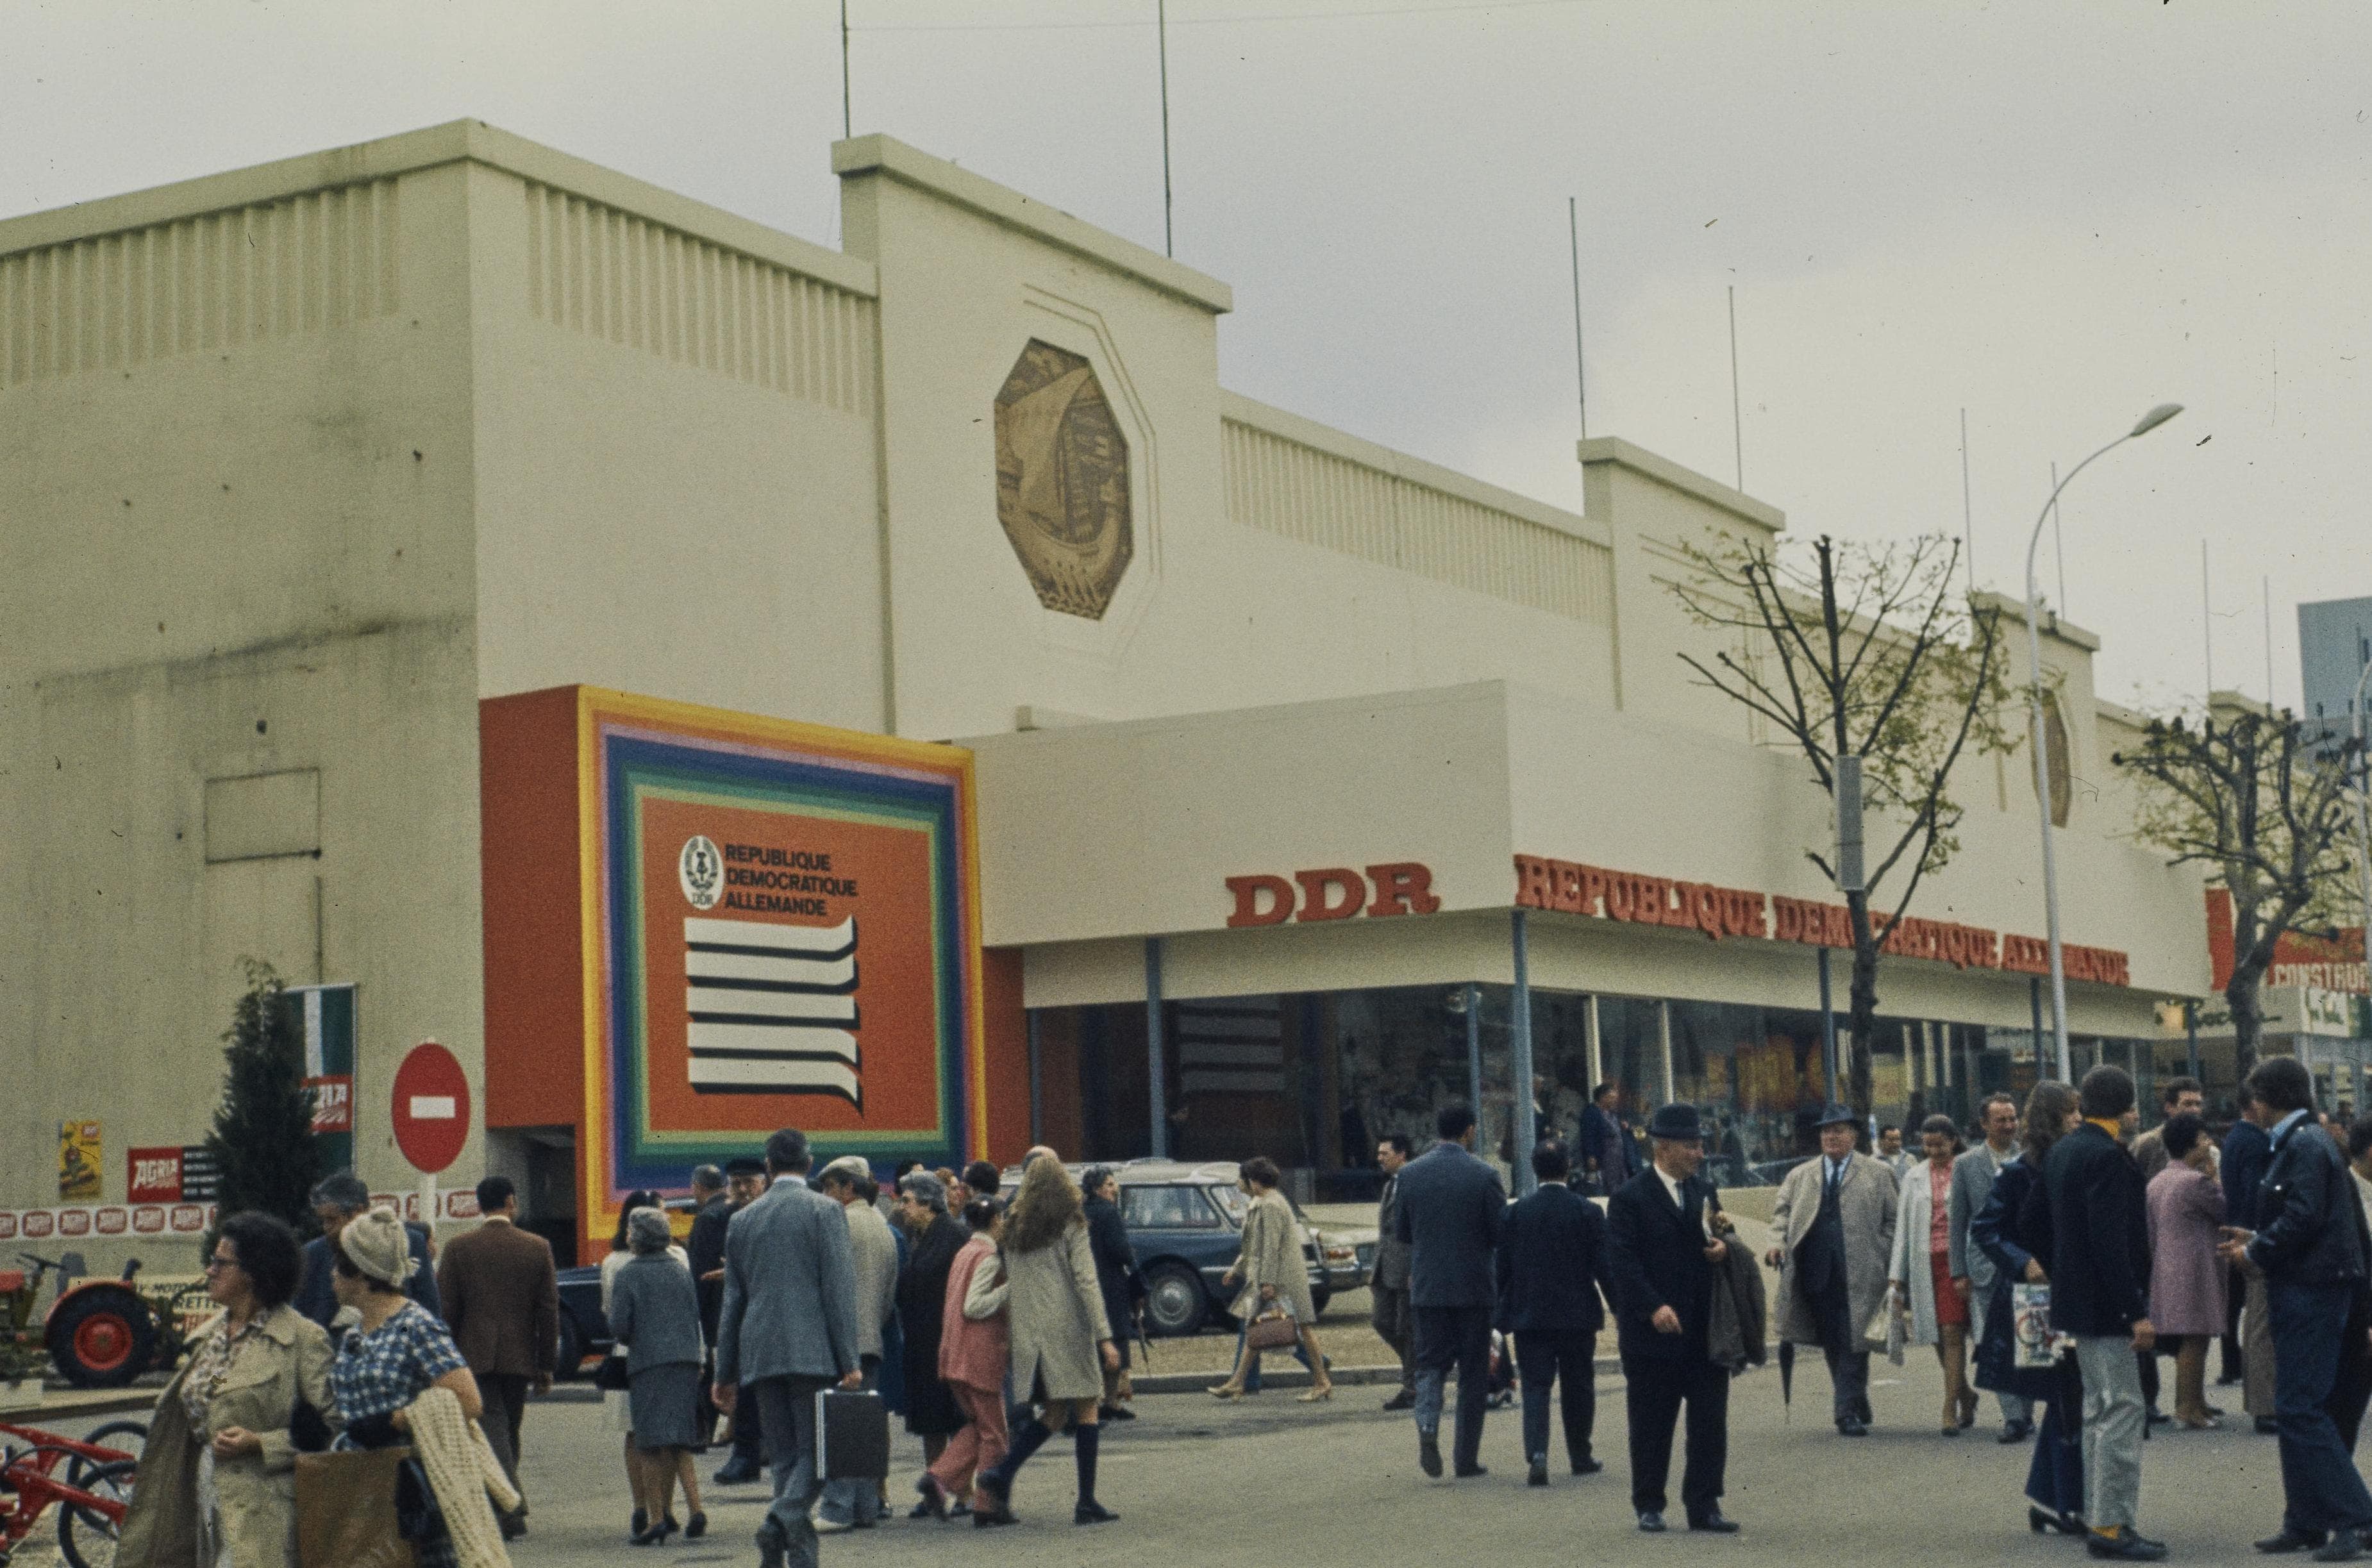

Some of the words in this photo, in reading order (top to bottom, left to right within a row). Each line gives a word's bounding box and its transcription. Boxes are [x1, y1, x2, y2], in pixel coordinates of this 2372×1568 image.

[725, 844, 830, 870] REPUBLIQUE
[727, 869, 856, 895] DEMOCRATIQUE
[1225, 862, 1441, 928] DDR
[725, 892, 826, 915] ALLEMANDE
[1514, 854, 1766, 940] REPUBLIQUE
